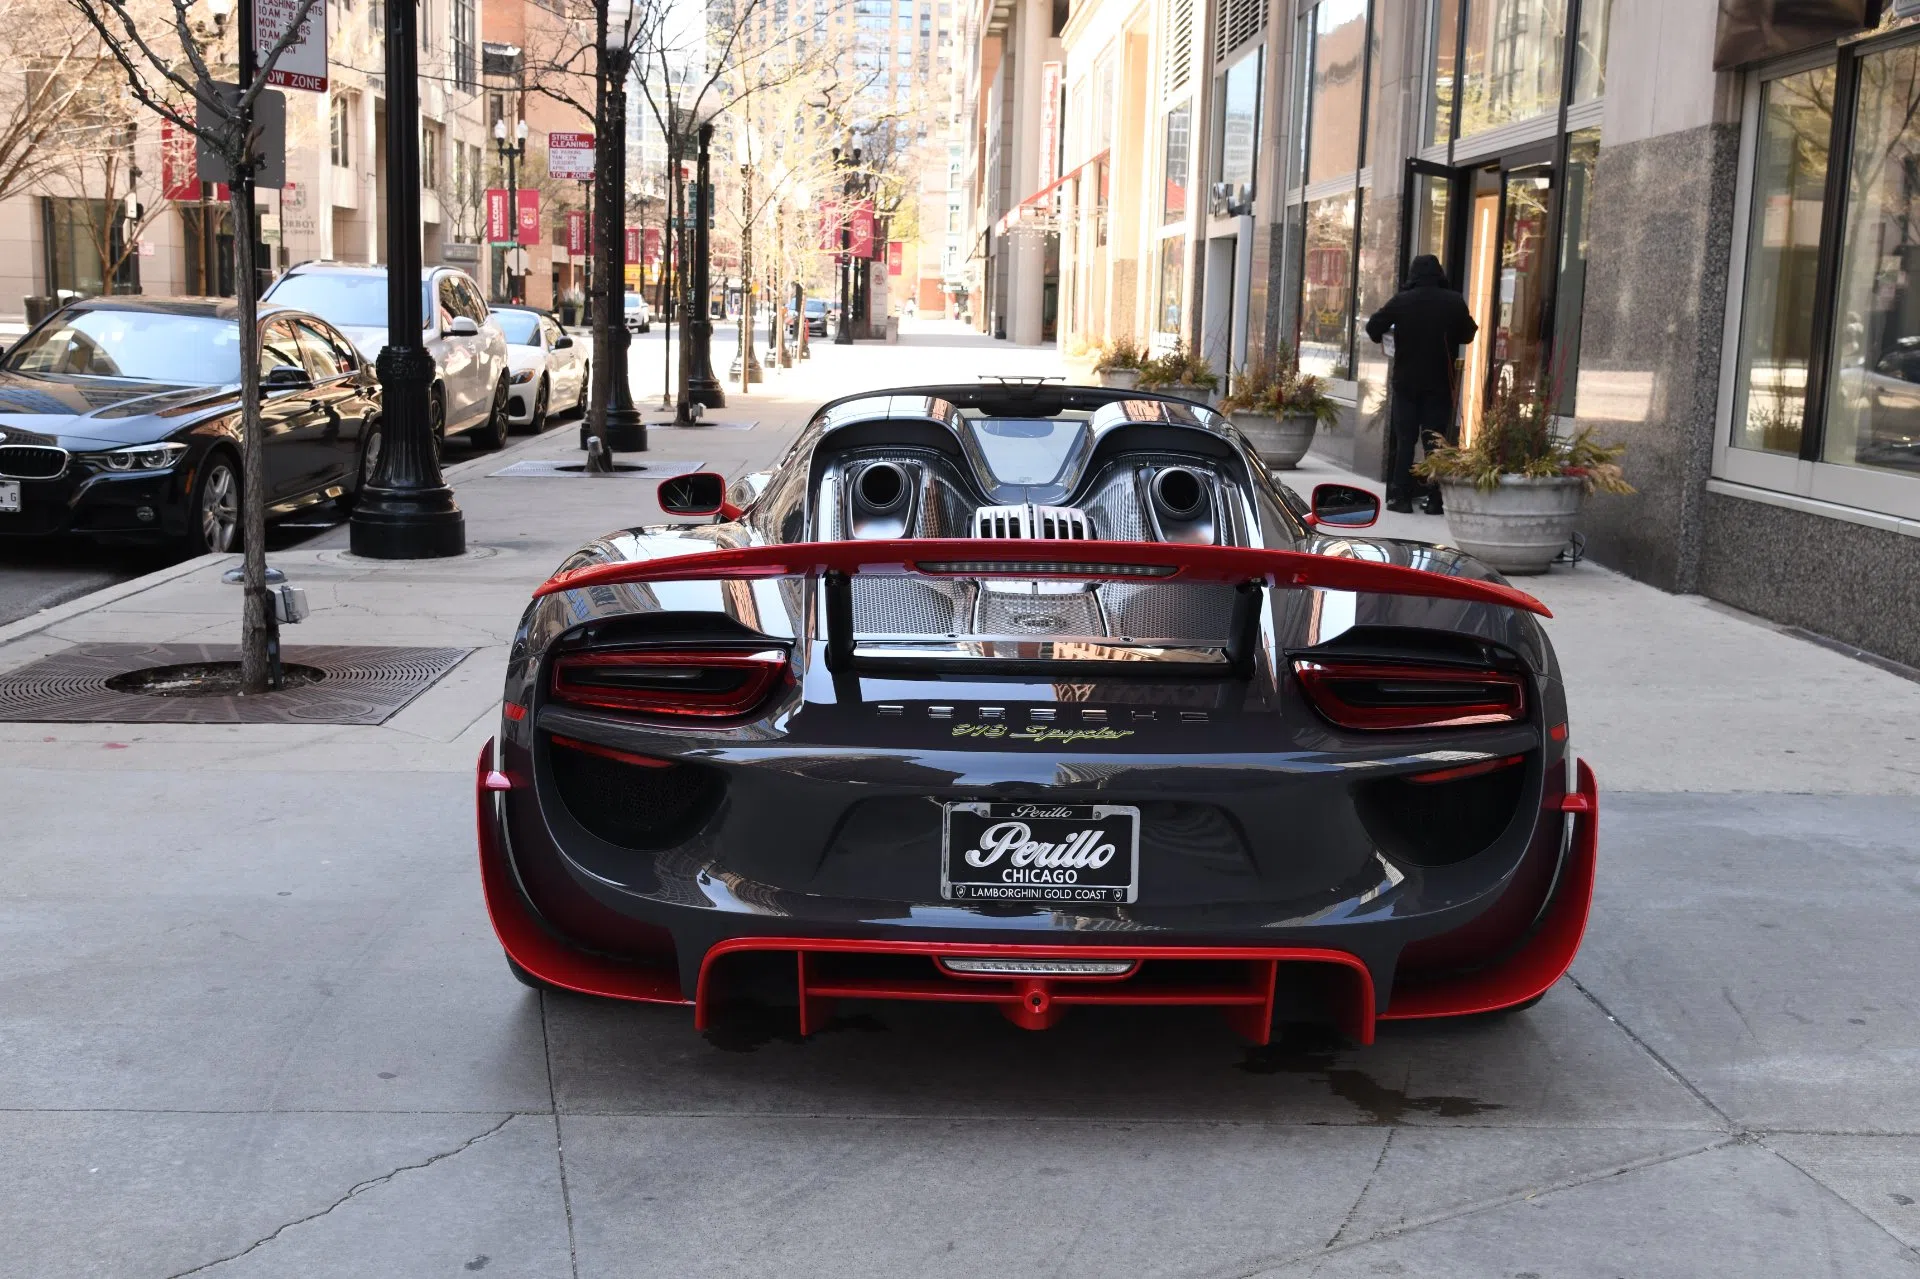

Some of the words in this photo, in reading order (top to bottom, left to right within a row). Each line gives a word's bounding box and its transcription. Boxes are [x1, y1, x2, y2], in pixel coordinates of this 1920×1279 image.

[259, 17, 276, 28] MON
[259, 40, 272, 49] FRI
[267, 71, 285, 84] OW
[291, 74, 321, 90] ZONE
[552, 140, 589, 148] CLEANING
[492, 195, 500, 237] WELCOME
[283, 220, 316, 228] ORBOY
[877, 705, 1209, 723] PORSCHE
[952, 723, 1008, 738] 918
[1010, 723, 1134, 743] Spyder
[1011, 805, 1073, 818] Perillo
[965, 821, 1116, 869] Perillo
[1002, 868, 1078, 884] CHICAGO
[971, 887, 1042, 898] LAMBORGHINI
[1044, 889, 1072, 899] GOLD
[1074, 890, 1107, 900] COAST
